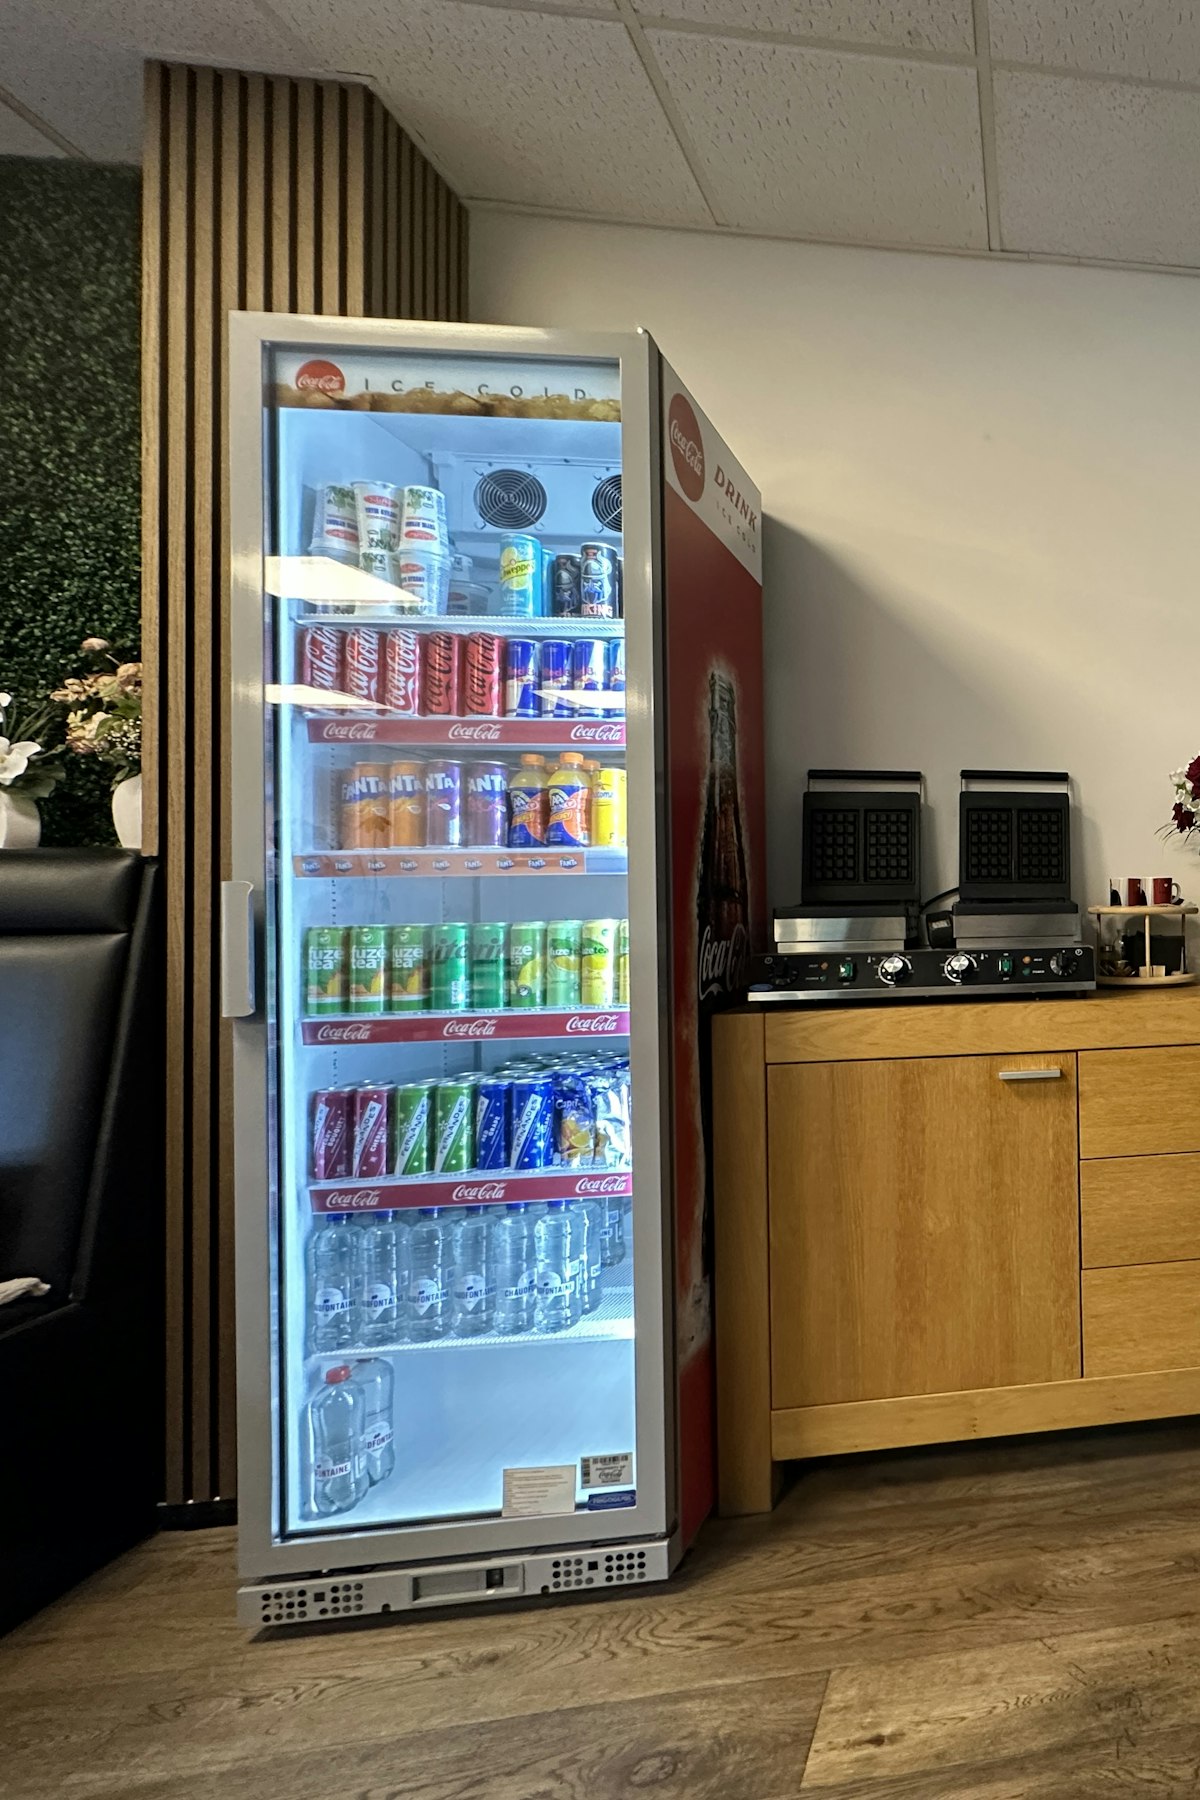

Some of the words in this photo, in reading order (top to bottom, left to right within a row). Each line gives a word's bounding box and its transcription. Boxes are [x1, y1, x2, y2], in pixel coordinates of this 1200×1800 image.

[670, 419, 703, 476] Coca-Cola
[713, 464, 757, 533] DRINK
[323, 722, 377, 739] Coca-Cola
[449, 723, 502, 739] Coca-Cola
[571, 724, 624, 740] Coca-Cola
[426, 773, 455, 791] NTA
[467, 774, 507, 793] ANTA
[309, 945, 344, 959] fuze
[308, 957, 334, 970] tea
[352, 957, 377, 969] tea
[317, 1023, 373, 1041] Coca-Cola
[443, 1019, 498, 1037] Coca-Cola
[566, 1015, 619, 1032] Coca-Cola
[452, 1183, 507, 1200] Coca-Cola
[575, 1175, 629, 1194] Coca-Cola
[326, 1190, 382, 1208] Coca-Cola
